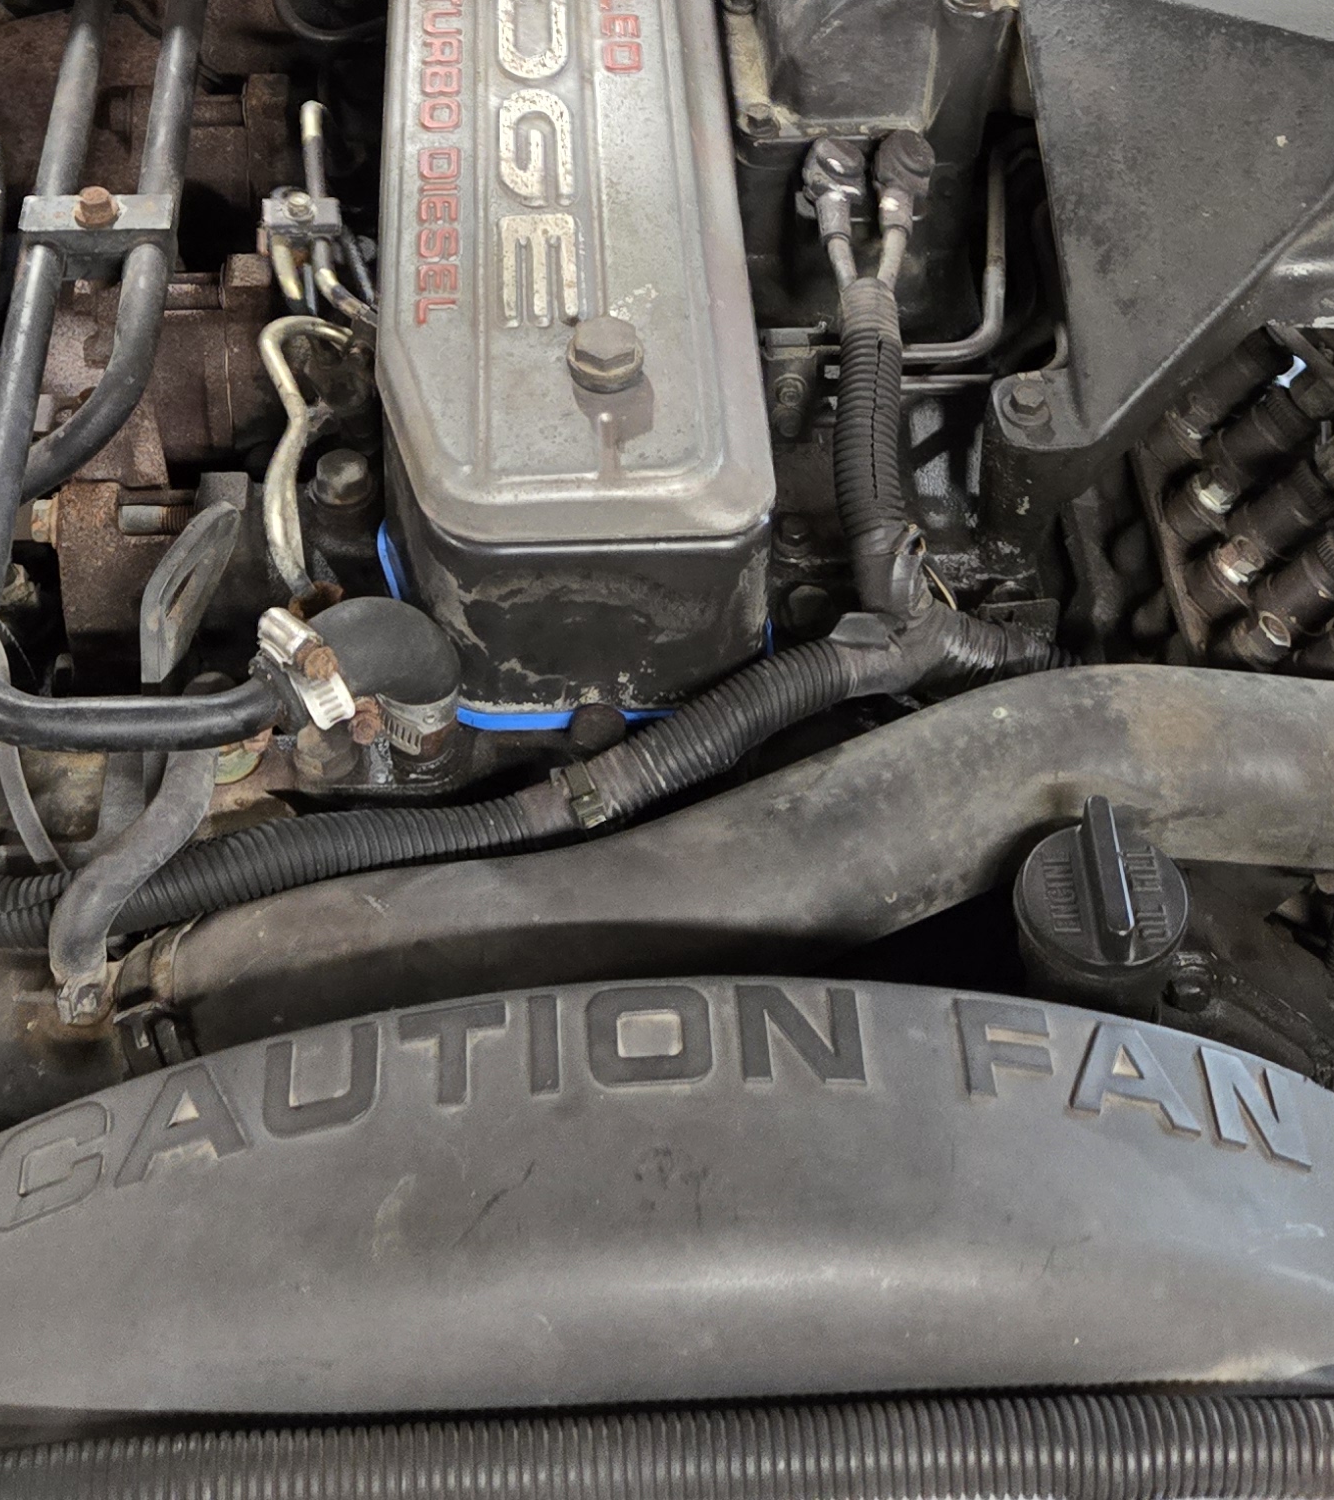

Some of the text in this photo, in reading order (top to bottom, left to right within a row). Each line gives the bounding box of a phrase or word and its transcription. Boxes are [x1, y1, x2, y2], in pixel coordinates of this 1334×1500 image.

[416, 146, 461, 325] DIESEL
[1041, 850, 1082, 934] ENGINE
[1123, 846, 1172, 943] OIL FILL
[952, 997, 1316, 1173] FAN
